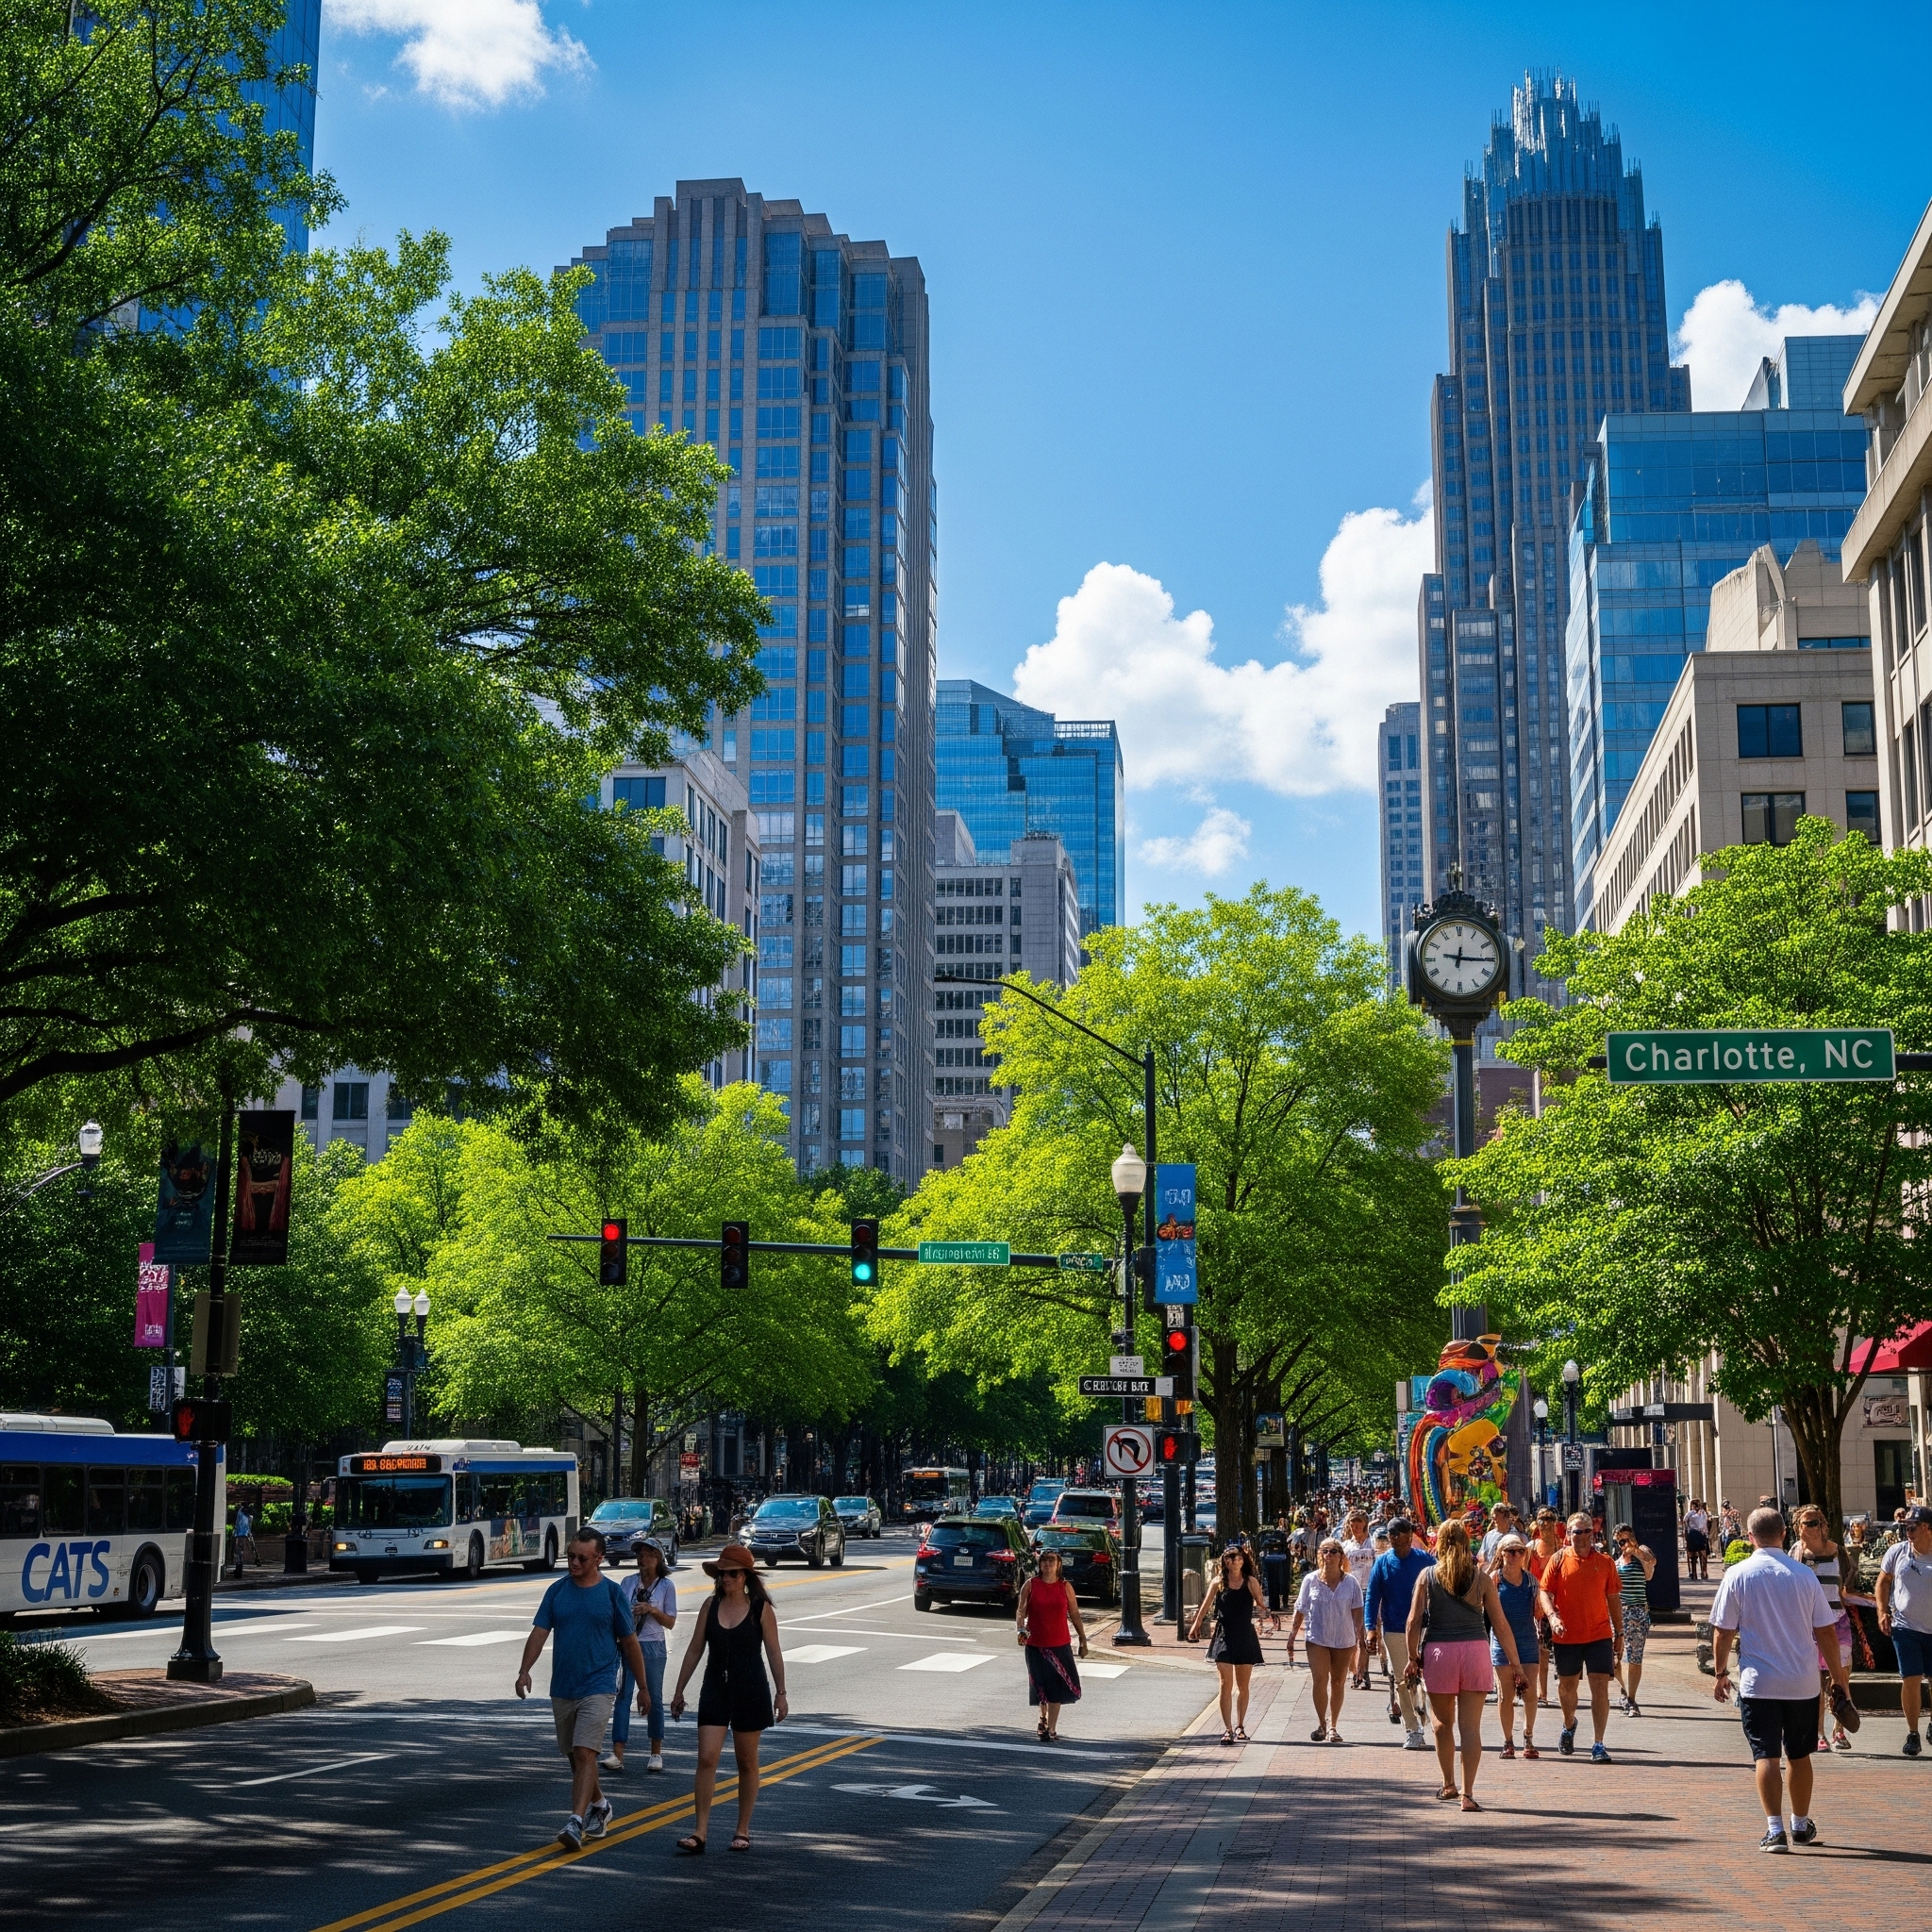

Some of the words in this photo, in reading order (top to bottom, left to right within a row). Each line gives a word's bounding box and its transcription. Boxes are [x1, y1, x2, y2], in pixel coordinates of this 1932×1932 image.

[1625, 1041, 1806, 1074] Charlotte,
[1825, 1039, 1874, 1069] NC
[22, 1540, 110, 1603] CATS
